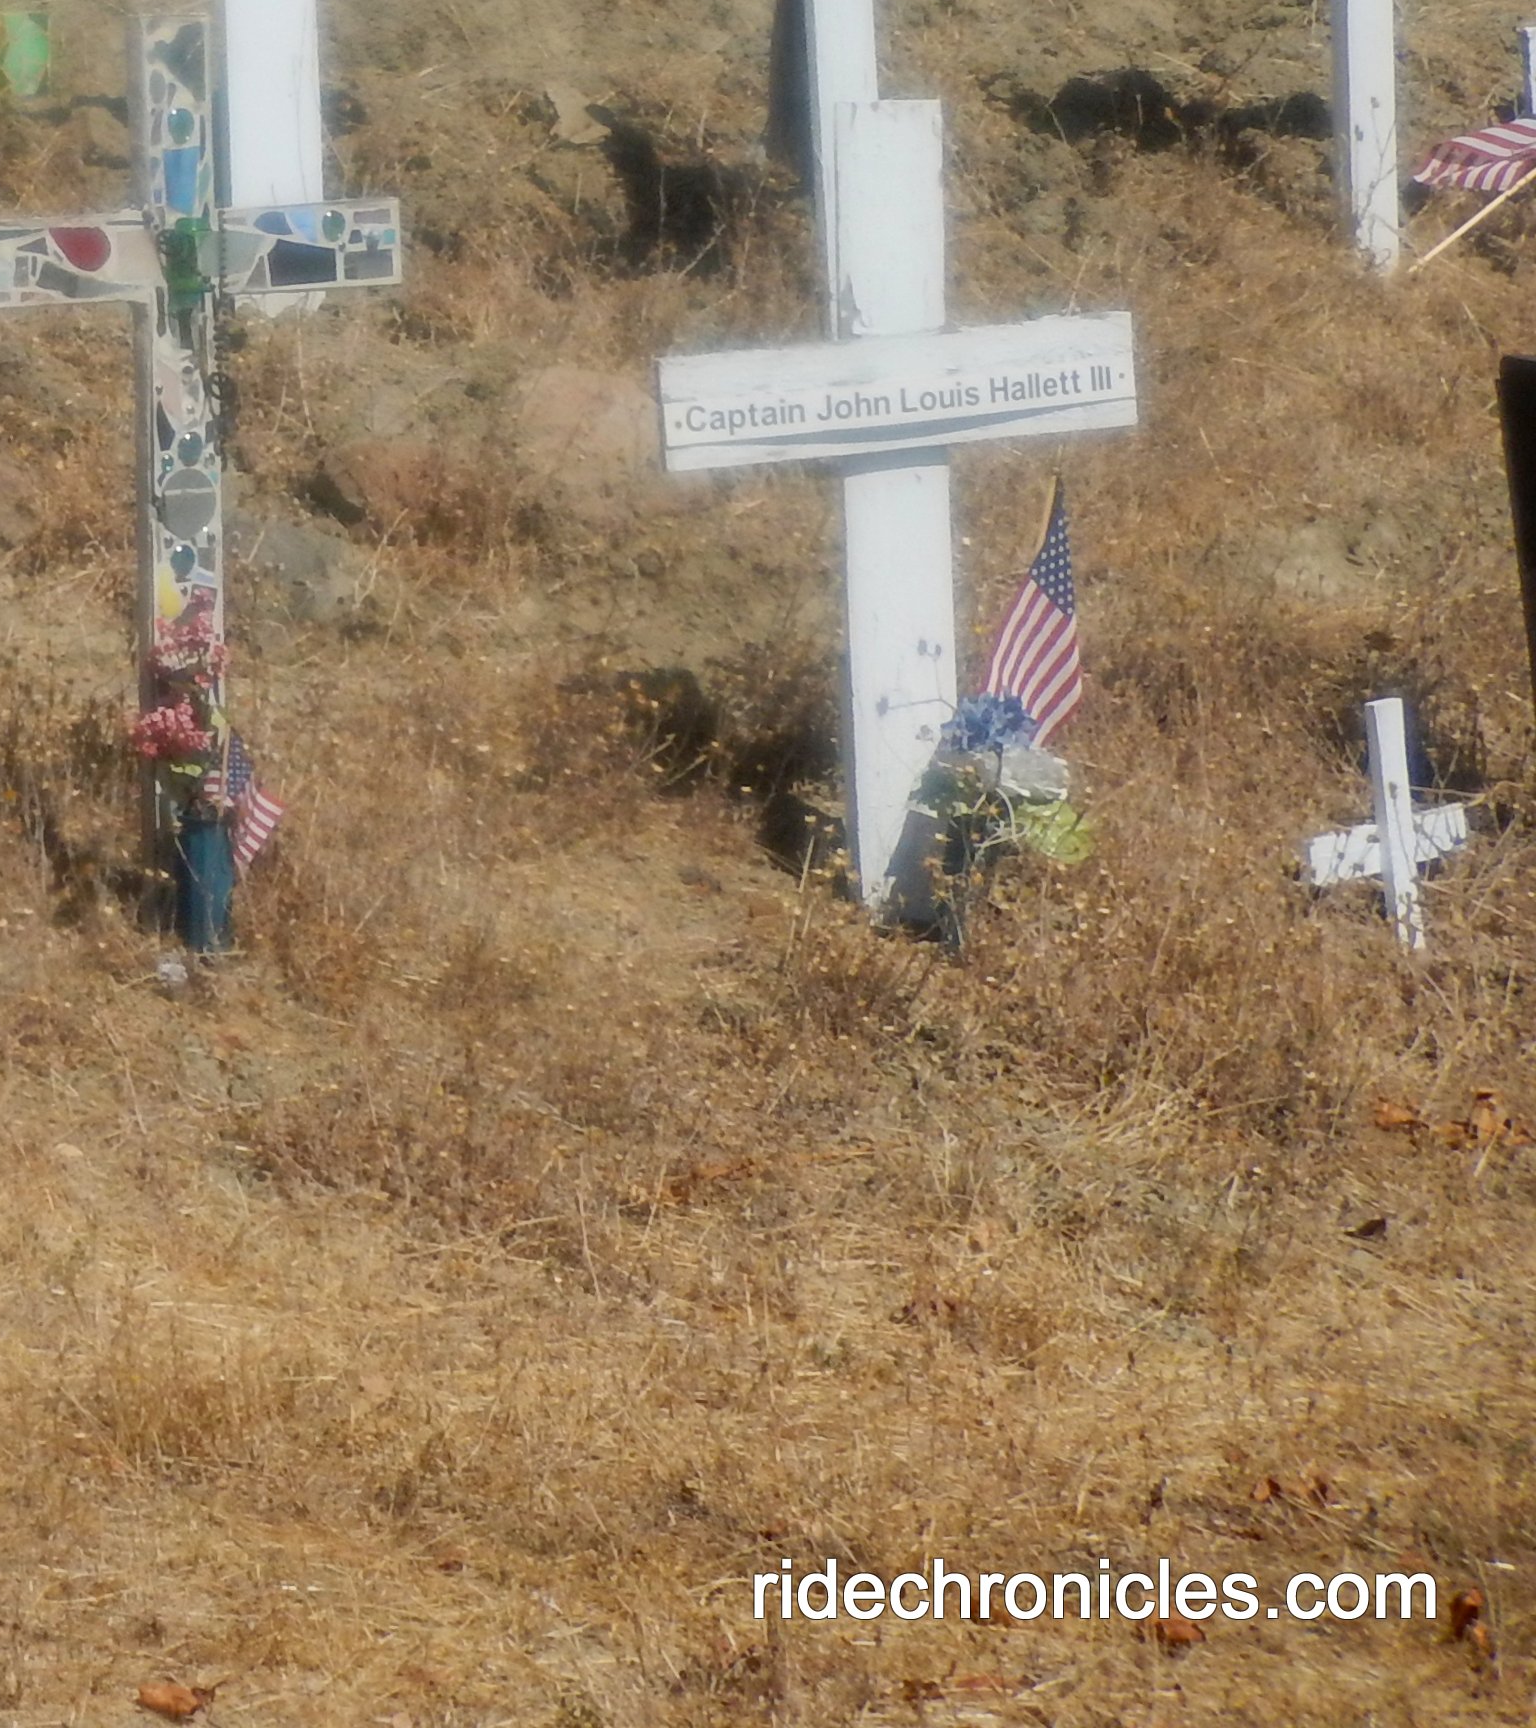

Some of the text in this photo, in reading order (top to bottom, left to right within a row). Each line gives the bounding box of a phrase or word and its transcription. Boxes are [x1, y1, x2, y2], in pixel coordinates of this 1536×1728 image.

[685, 365, 1113, 436] Captain John Louis Hallett III
